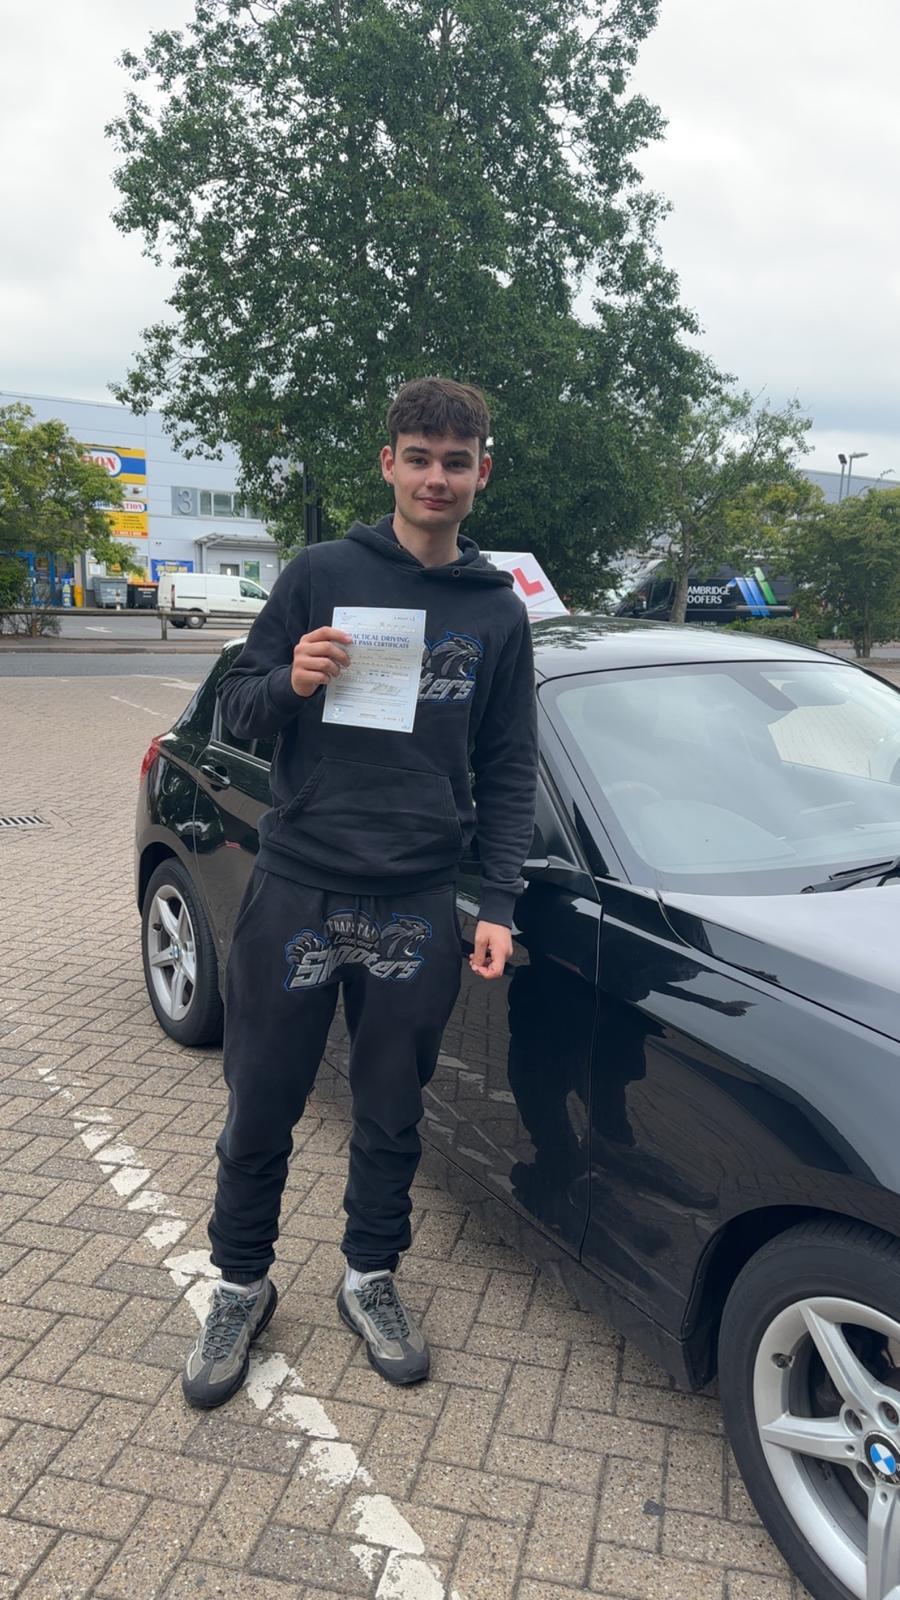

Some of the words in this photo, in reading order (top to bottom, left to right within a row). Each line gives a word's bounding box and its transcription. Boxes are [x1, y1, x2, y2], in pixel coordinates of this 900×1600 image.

[178, 489, 192, 514] 3
[511, 567, 545, 597] L
[688, 586, 730, 595] AMBRIDGE
[687, 595, 722, 604] OOFERS
[352, 633, 379, 641] ACTICAL
[417, 673, 475, 700] ters
